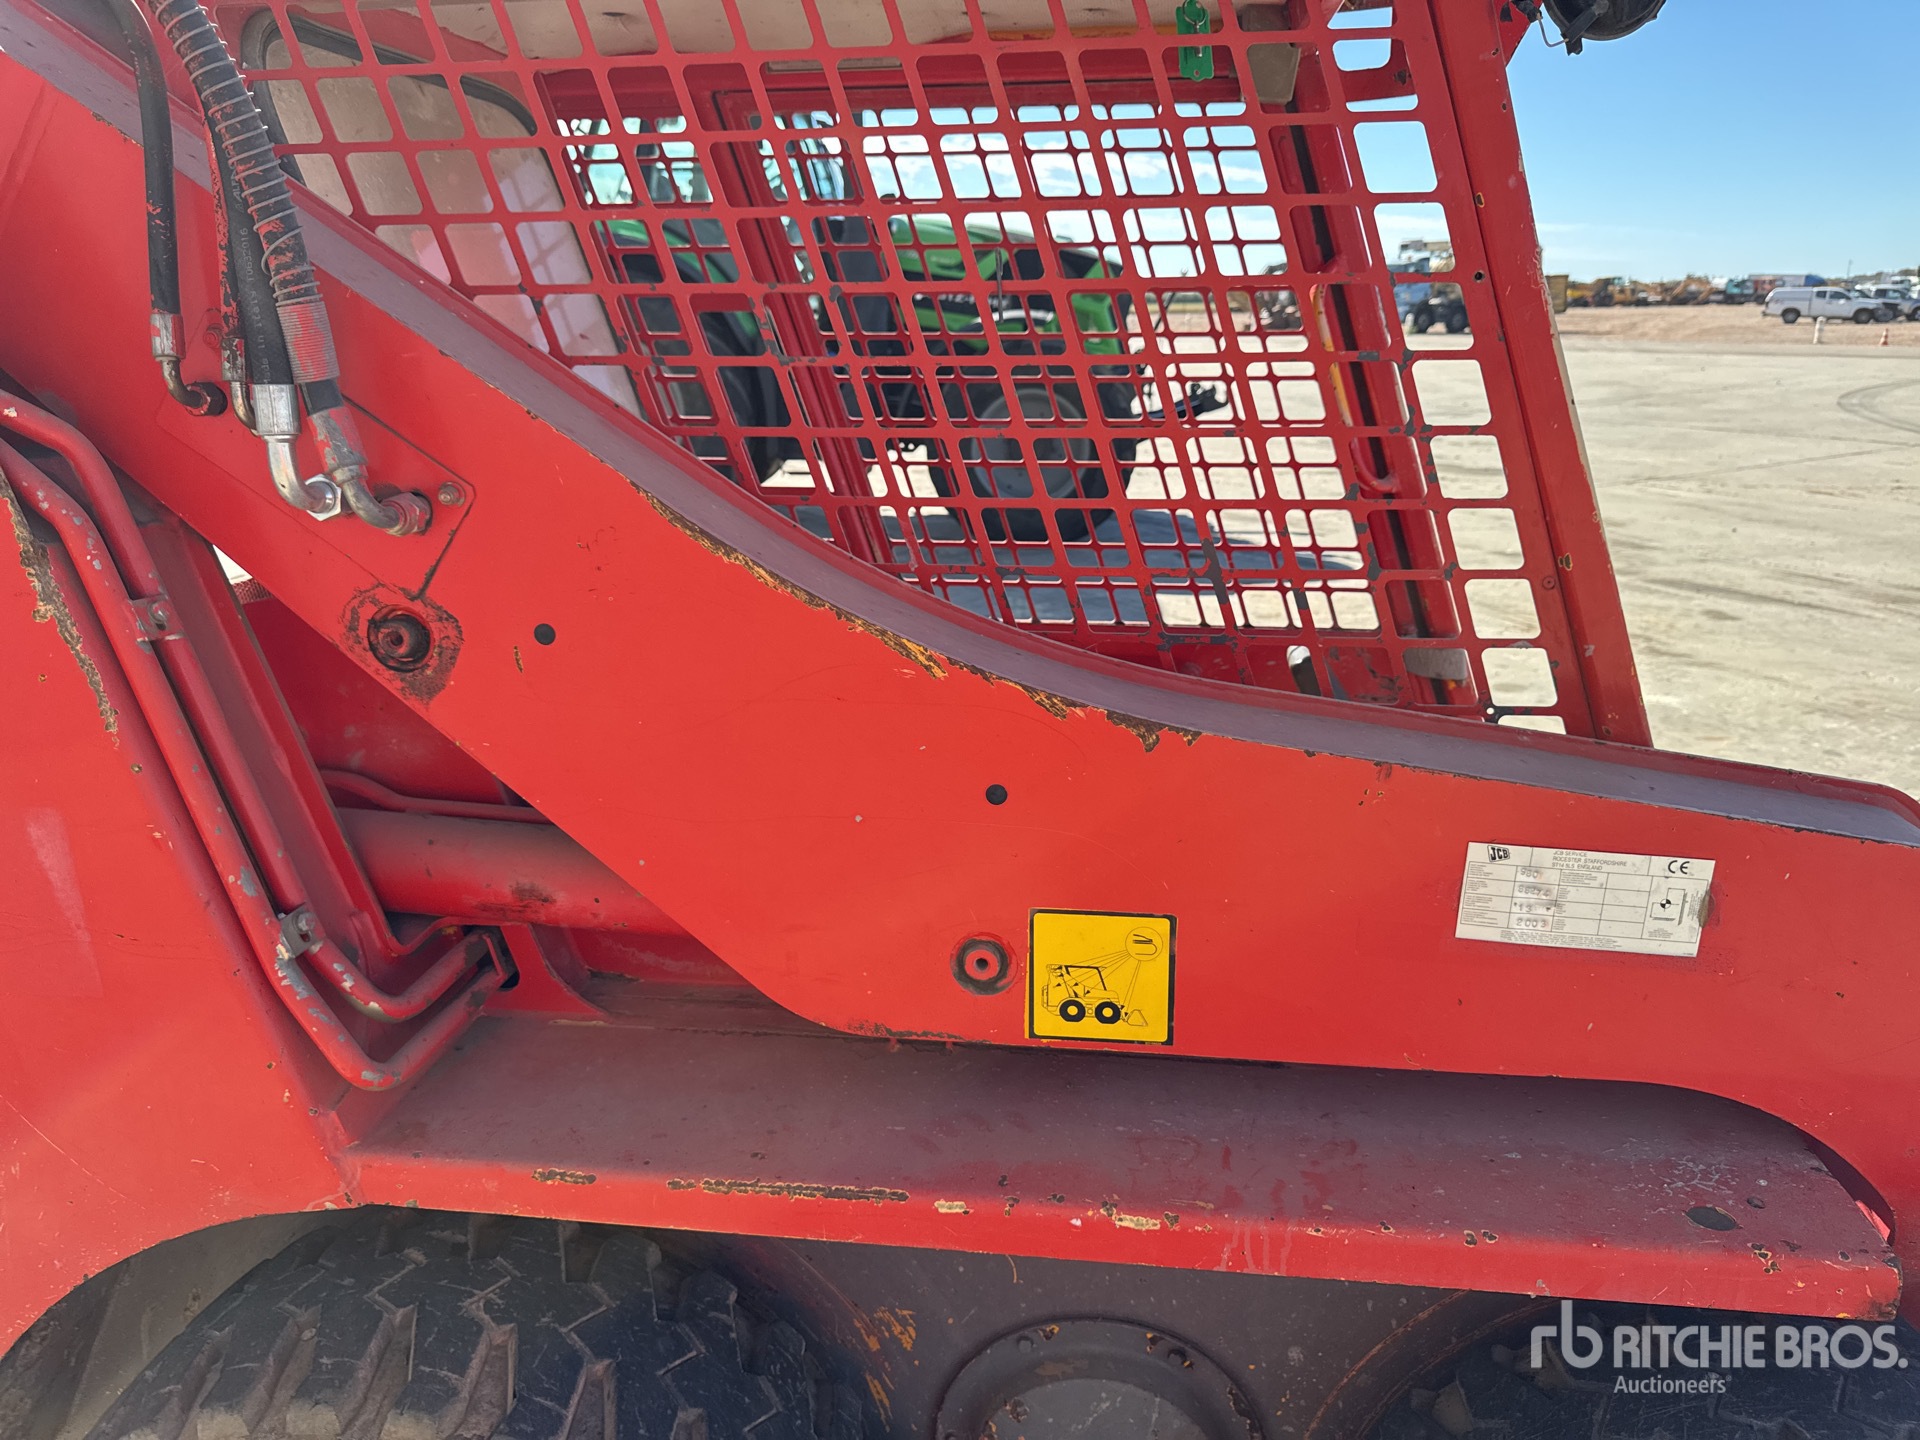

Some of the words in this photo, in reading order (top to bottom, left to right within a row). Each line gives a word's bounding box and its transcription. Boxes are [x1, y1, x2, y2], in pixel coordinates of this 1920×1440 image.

[1489, 846, 1509, 861] JCB
[1577, 863, 1603, 871] ENGLAND
[1583, 857, 1628, 867] STAFFORDSHIRE
